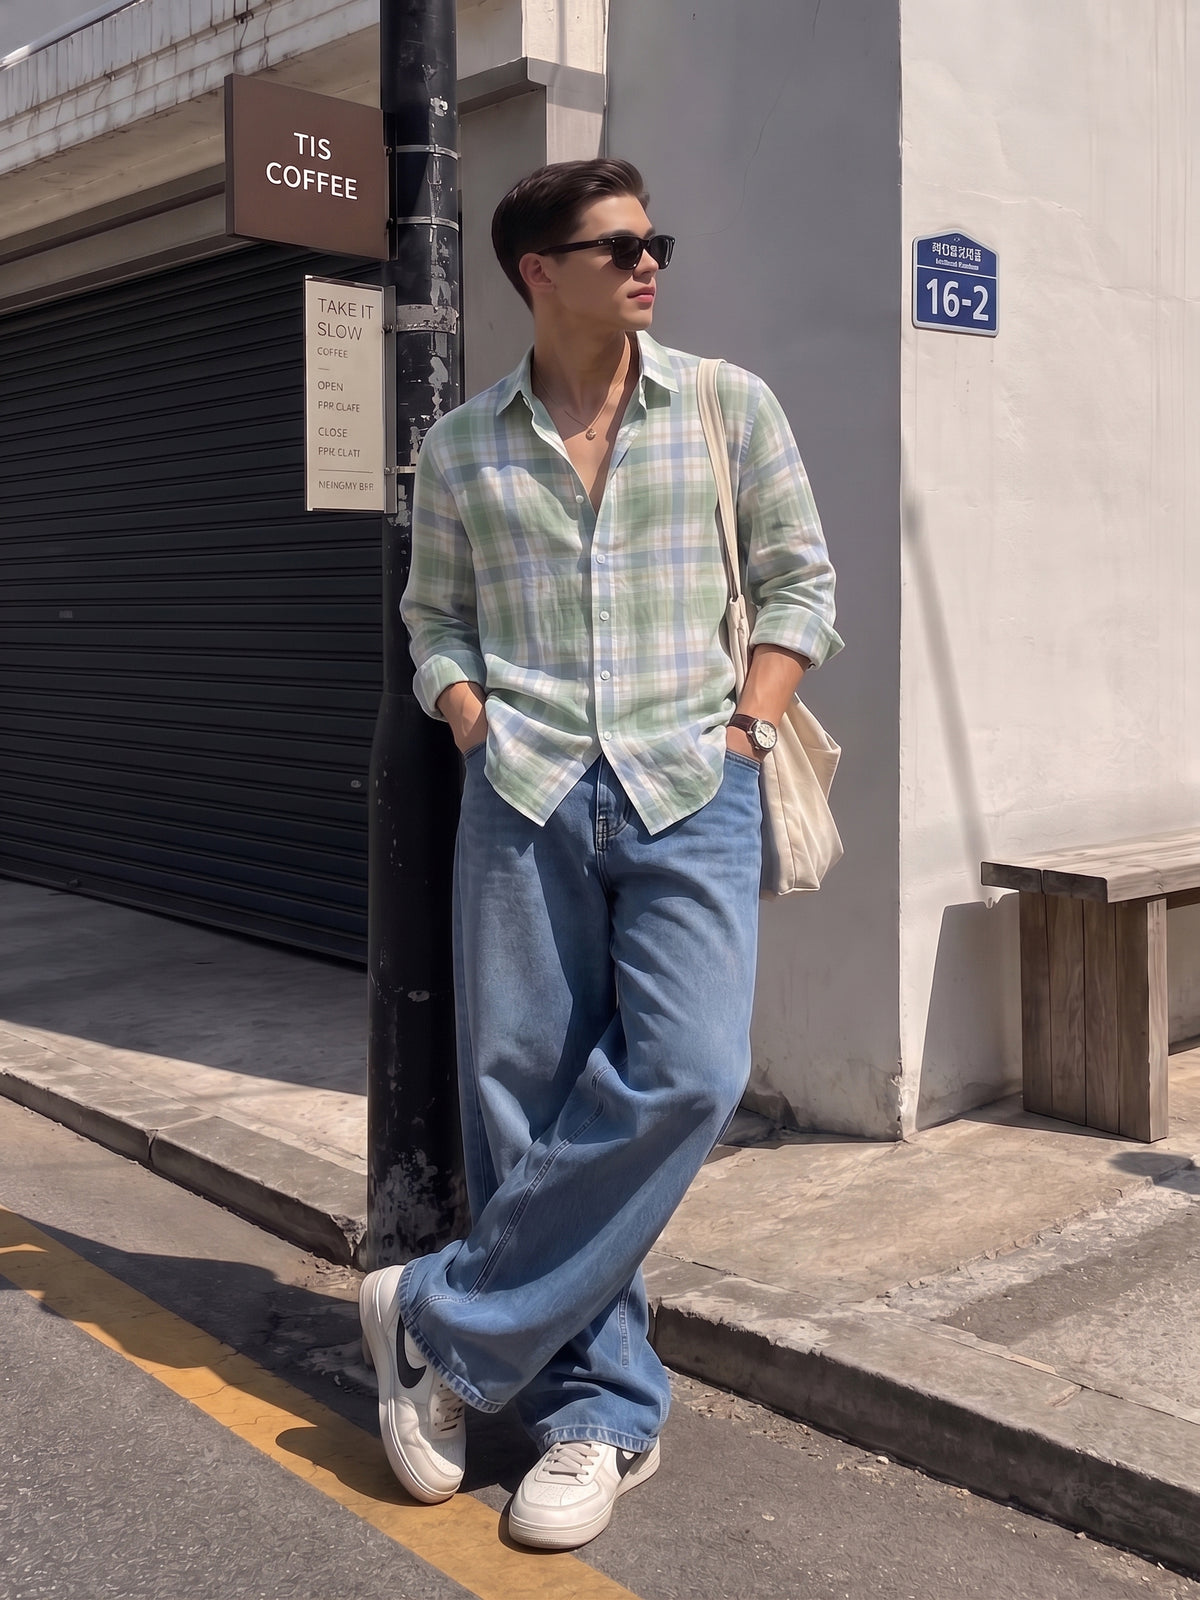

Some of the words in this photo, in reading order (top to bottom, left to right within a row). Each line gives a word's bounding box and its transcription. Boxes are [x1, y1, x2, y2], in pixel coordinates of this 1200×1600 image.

[293, 132, 332, 160] TIS
[266, 162, 358, 200] COFFEE
[317, 298, 357, 318] TAKE
[361, 305, 374, 319] IT
[926, 278, 989, 321] 16-2
[317, 321, 362, 341] SLOW
[317, 347, 348, 358] COFFEE
[317, 380, 344, 392] OPEN
[318, 427, 348, 437] CLOSE
